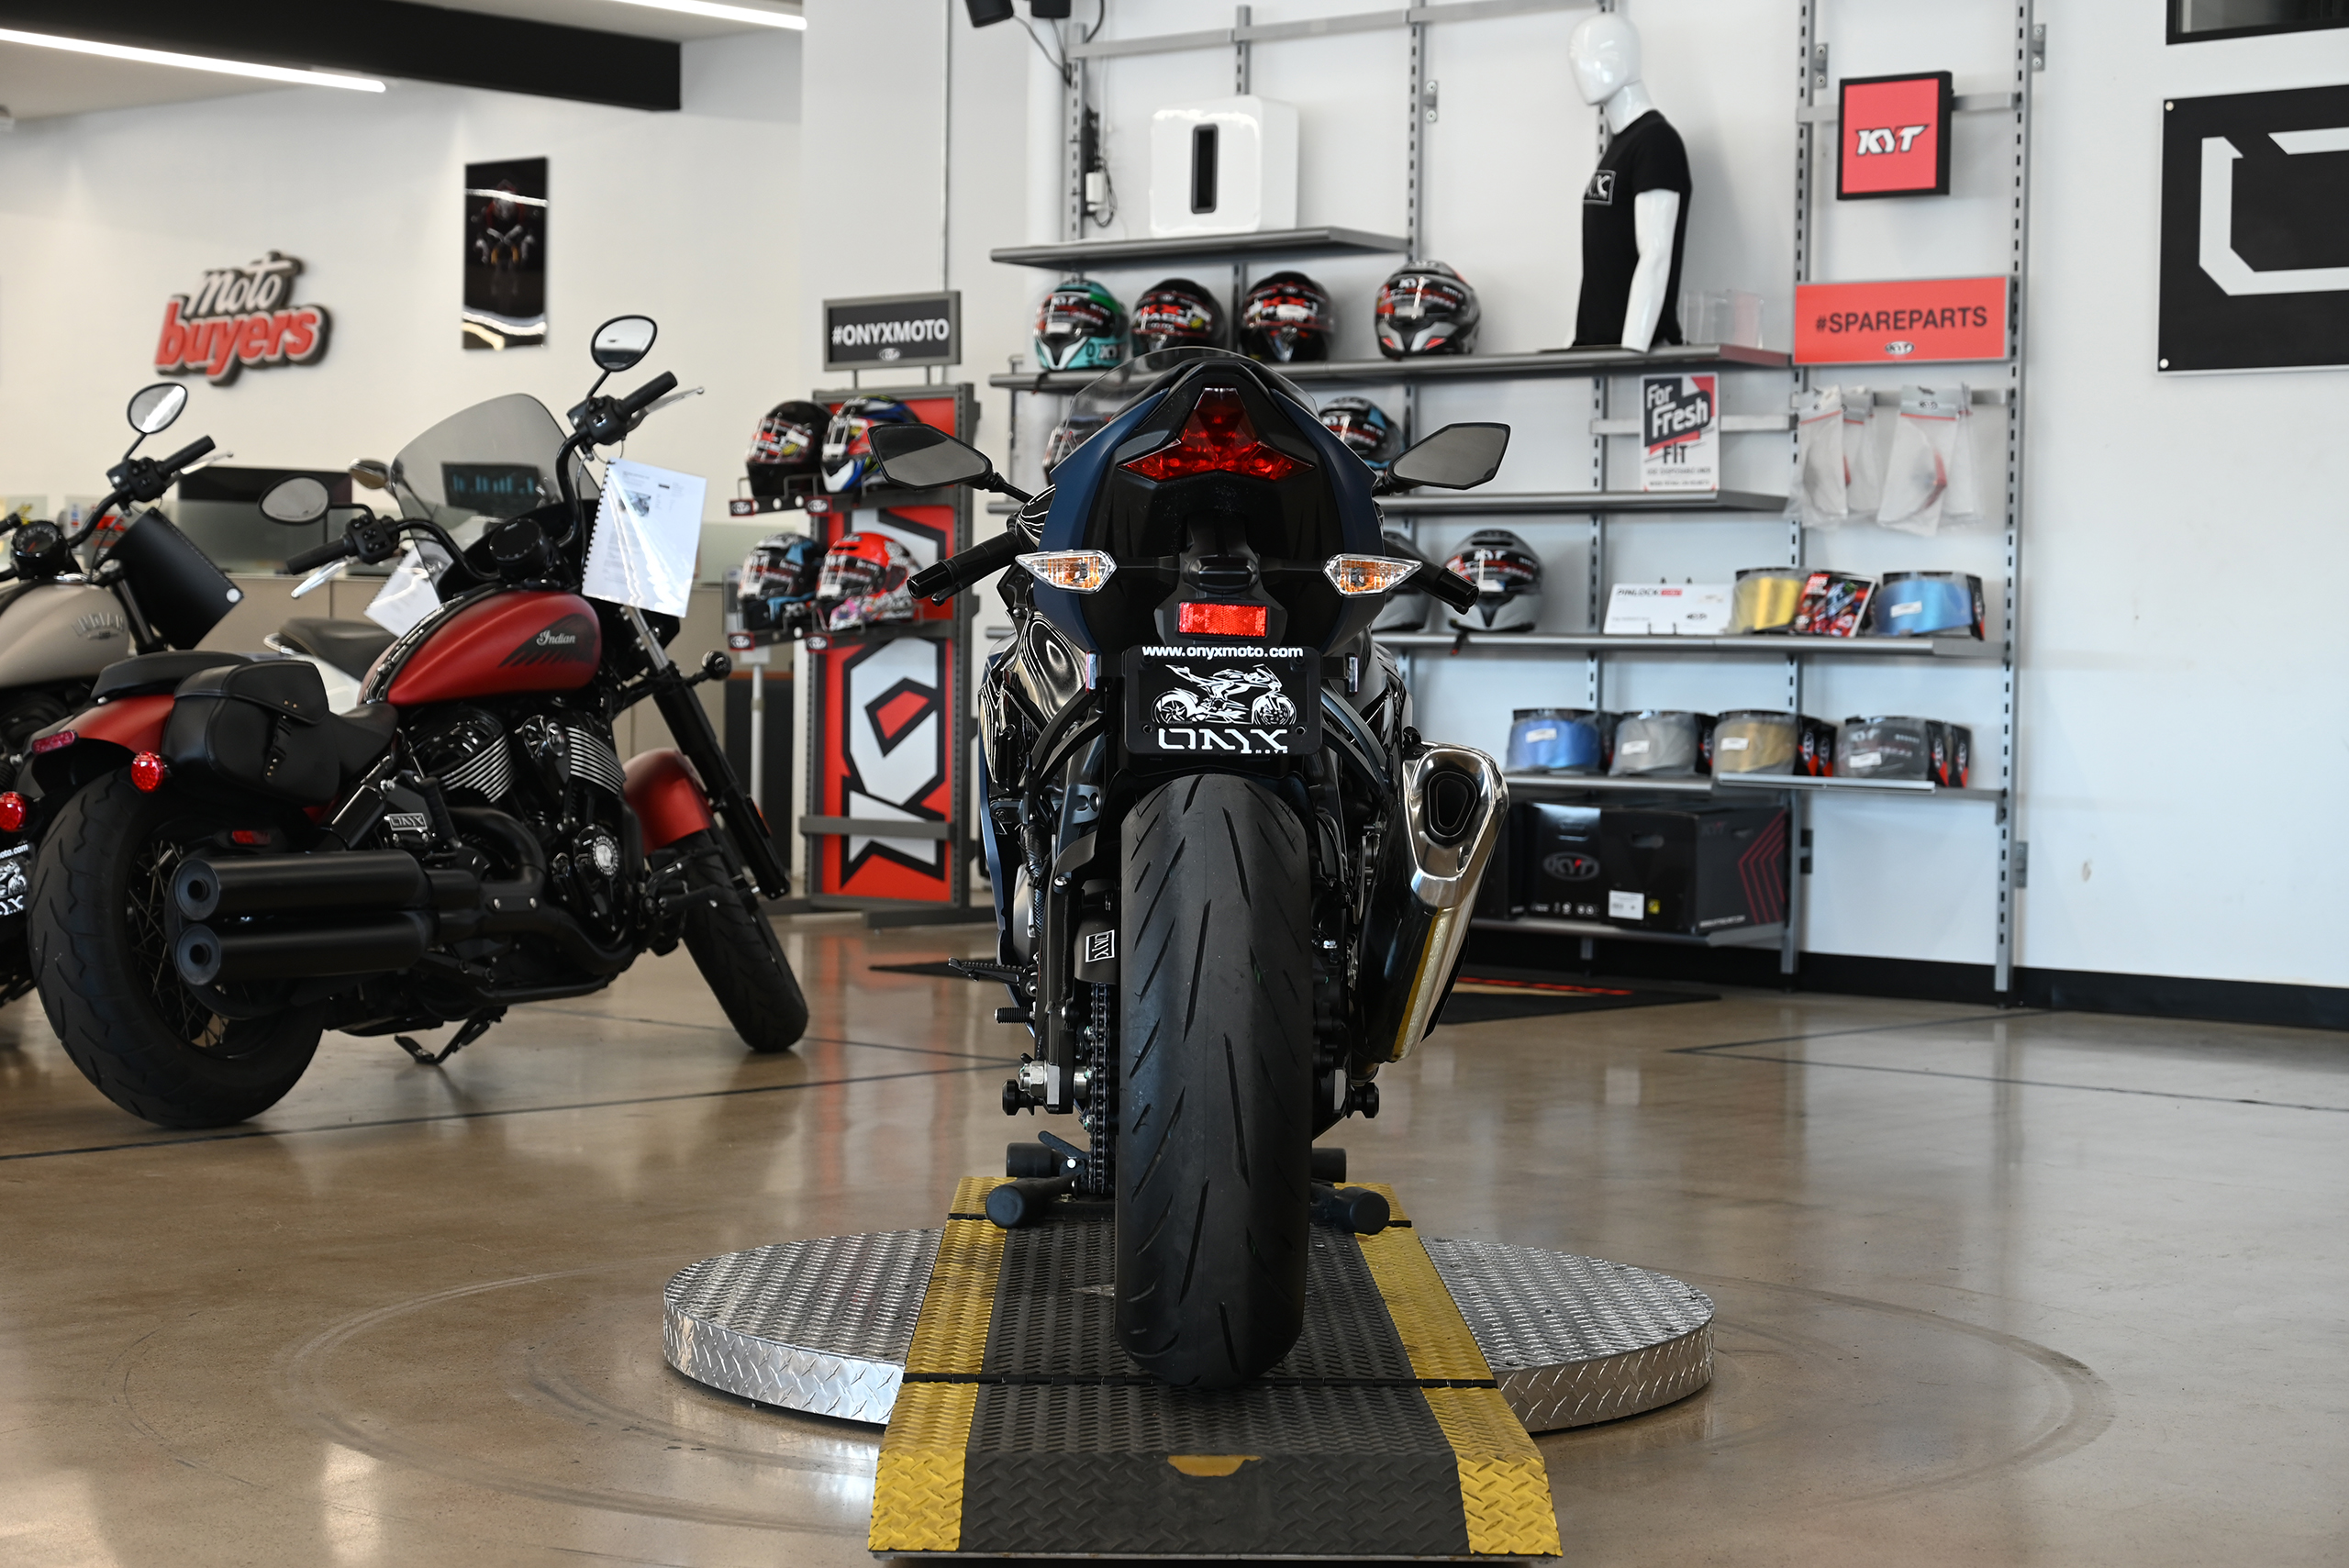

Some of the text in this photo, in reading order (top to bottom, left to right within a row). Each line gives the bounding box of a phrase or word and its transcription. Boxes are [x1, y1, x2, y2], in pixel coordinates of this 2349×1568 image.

[1855, 124, 1929, 156] KYT
[184, 252, 292, 317] Moto
[831, 317, 950, 347] #ONYXMOTO
[1815, 306, 1987, 334] #SPAREPARTS
[154, 298, 320, 379] buyers
[1647, 384, 1674, 410] For
[1653, 397, 1709, 439] Fresh
[536, 629, 576, 646] Indian
[1141, 645, 1304, 660] www.onyxmoto.com
[1158, 728, 1288, 754] ONYX
[0, 843, 28, 859] oto.com
[1092, 933, 1109, 959] ONYX
